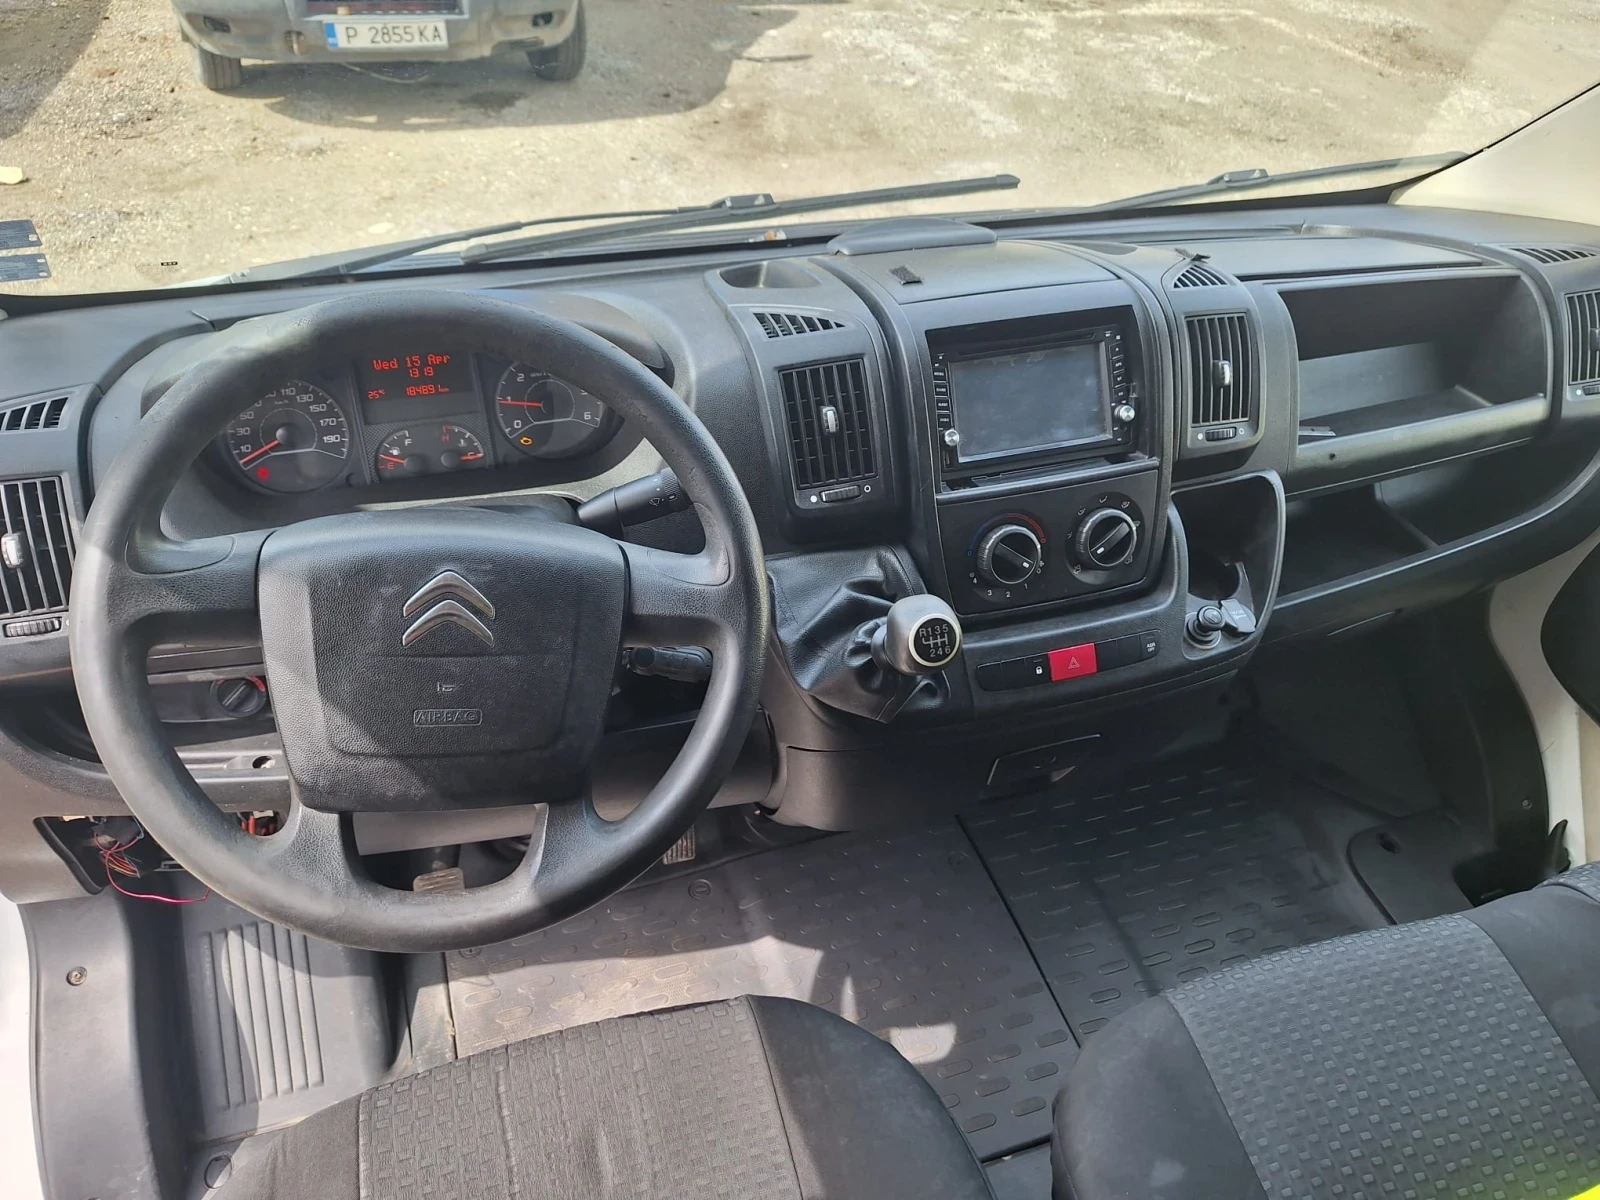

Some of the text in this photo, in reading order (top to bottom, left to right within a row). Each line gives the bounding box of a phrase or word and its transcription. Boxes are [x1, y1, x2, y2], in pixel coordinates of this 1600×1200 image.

[373, 354, 450, 370] Wed 15 Apr
[517, 373, 525, 382] 2
[281, 387, 296, 396] 110
[296, 393, 314, 403] 130
[309, 403, 327, 413] 150
[240, 411, 255, 420] 50
[584, 411, 591, 420] 6
[320, 418, 337, 427] 170
[513, 420, 522, 429] 0
[236, 427, 251, 436] 30
[322, 434, 341, 444] 190
[240, 444, 252, 454] 10
[919, 628, 927, 637] R
[934, 625, 941, 634] 3
[942, 623, 949, 632] 5
[929, 645, 951, 657] 2 4 6
[416, 711, 478, 722] AIRBAG
